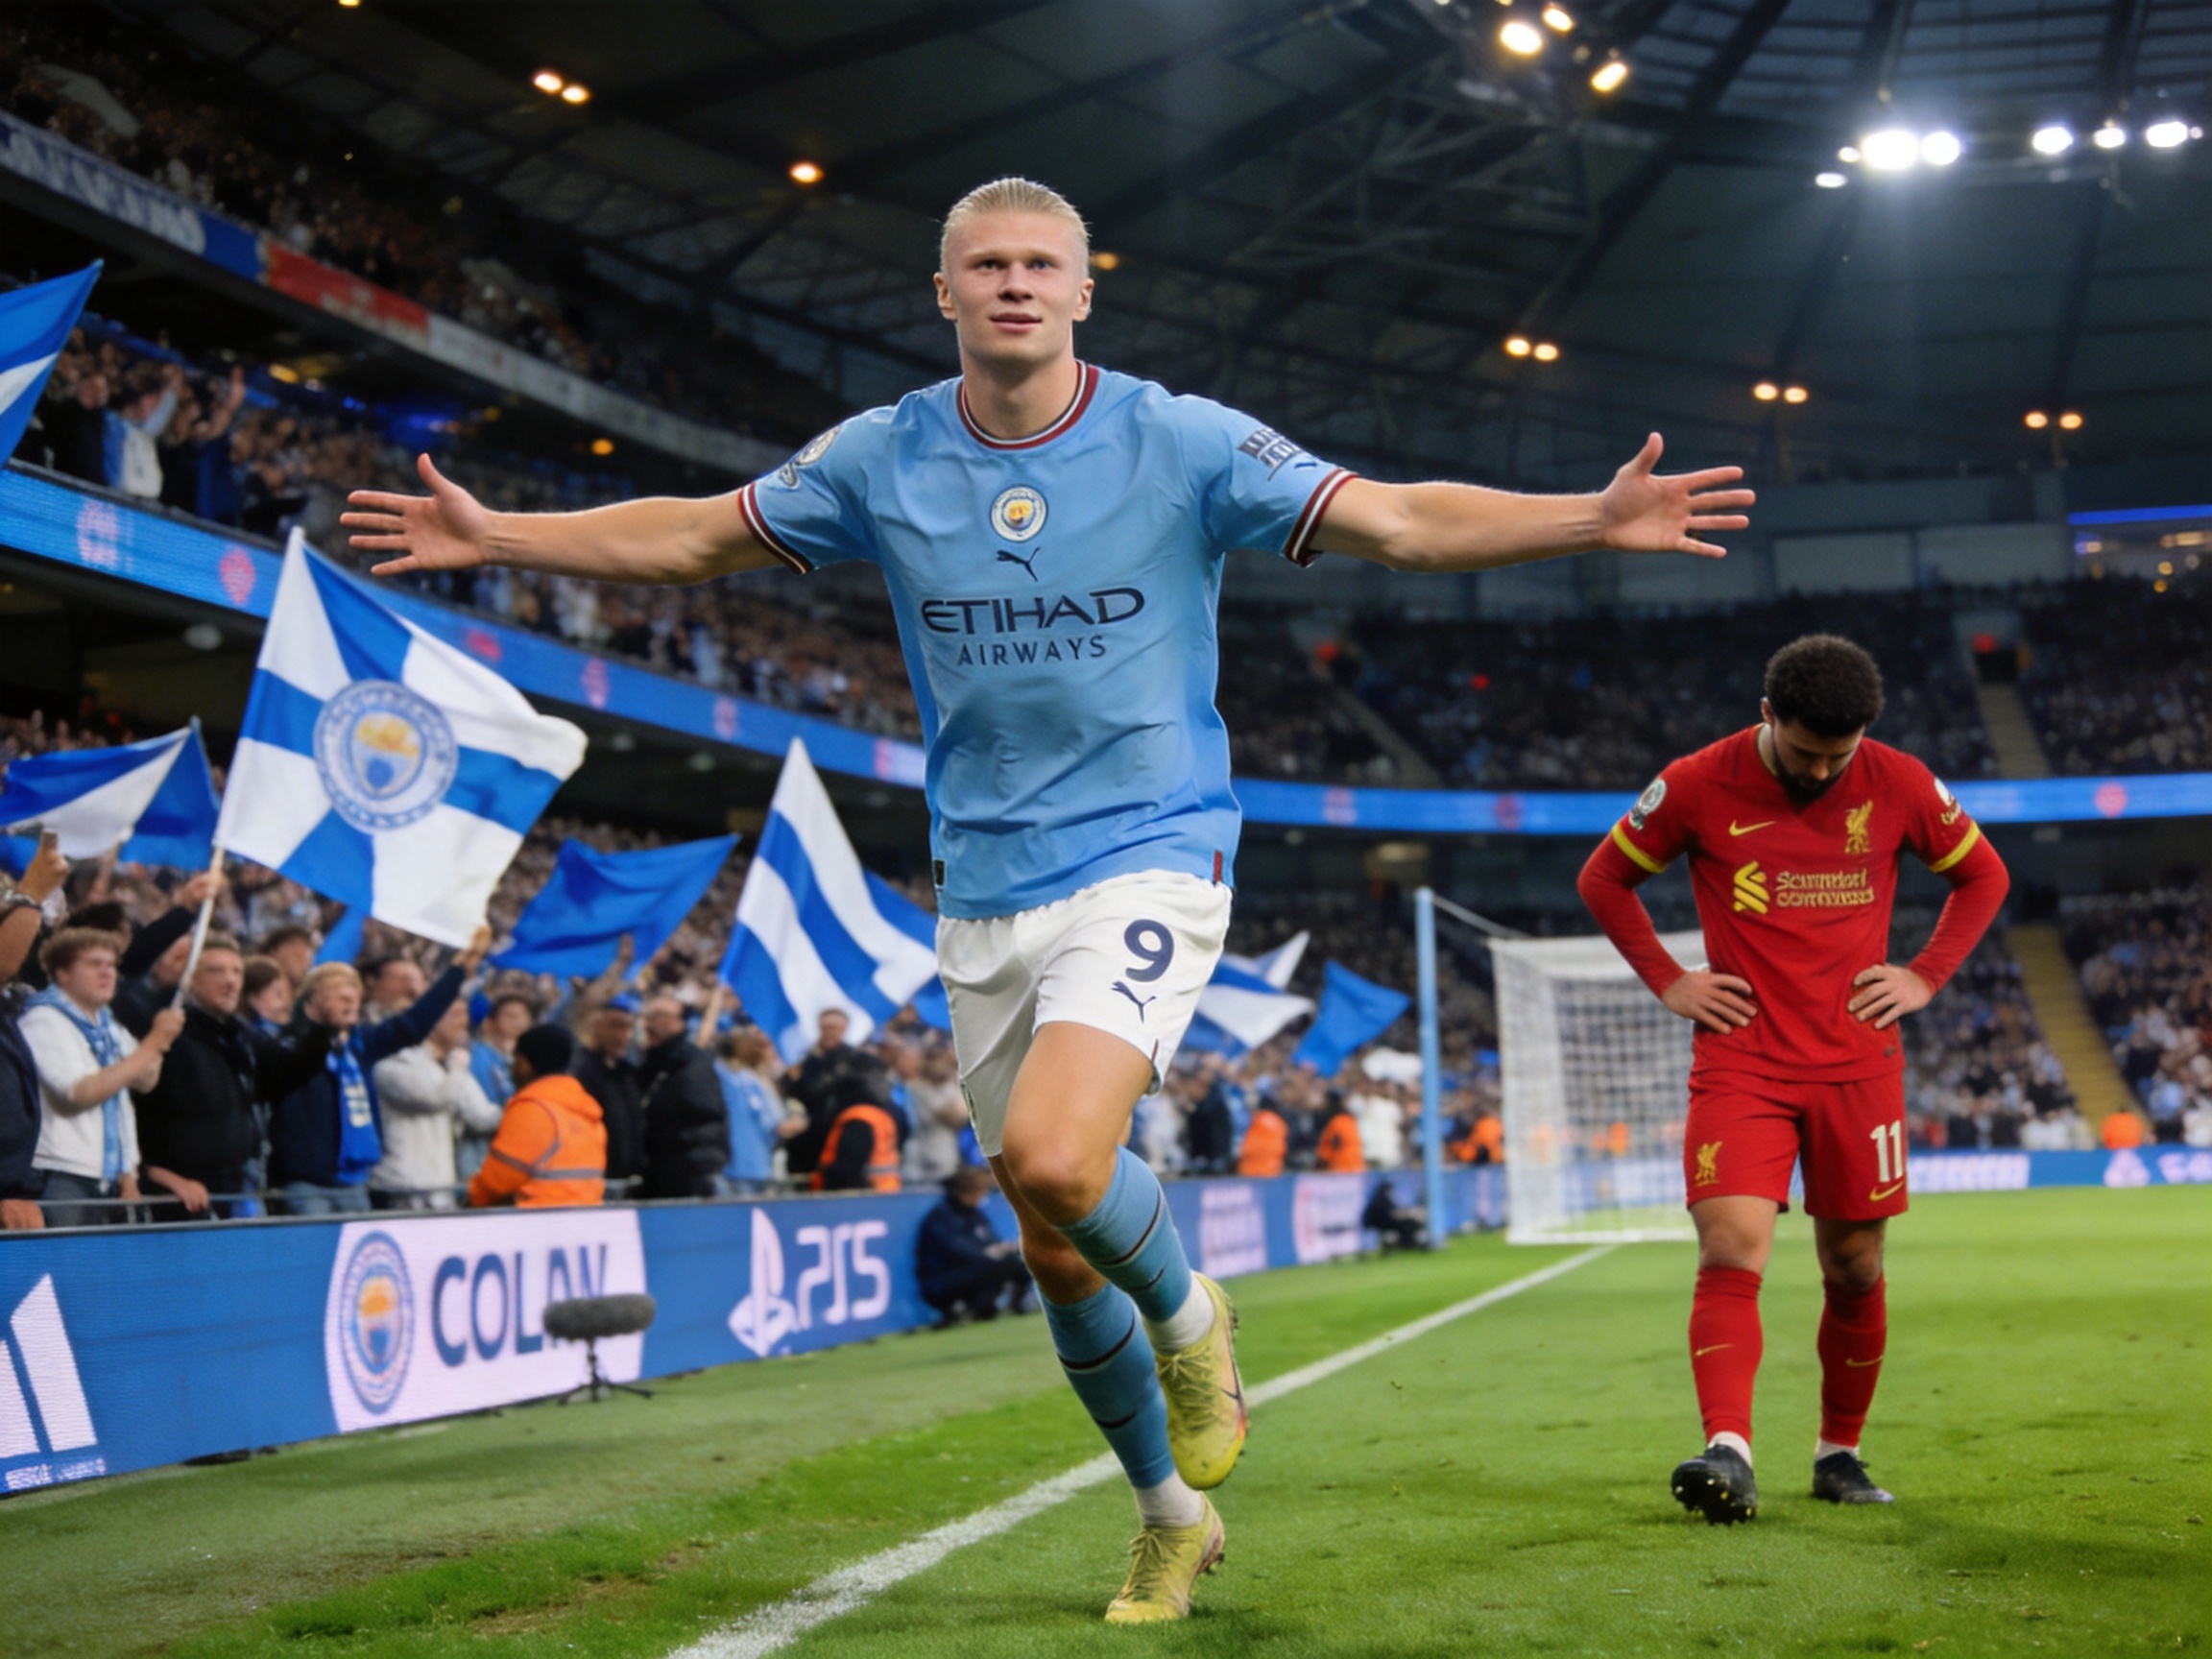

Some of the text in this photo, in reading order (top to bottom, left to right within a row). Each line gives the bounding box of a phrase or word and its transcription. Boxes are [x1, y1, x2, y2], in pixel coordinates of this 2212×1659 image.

[921, 587, 1145, 635] ETIHAD
[957, 635, 1107, 666] AIRWAYS
[1123, 919, 1175, 983] 9
[1869, 1119, 1904, 1183] 11
[796, 1218, 891, 1331] PS5
